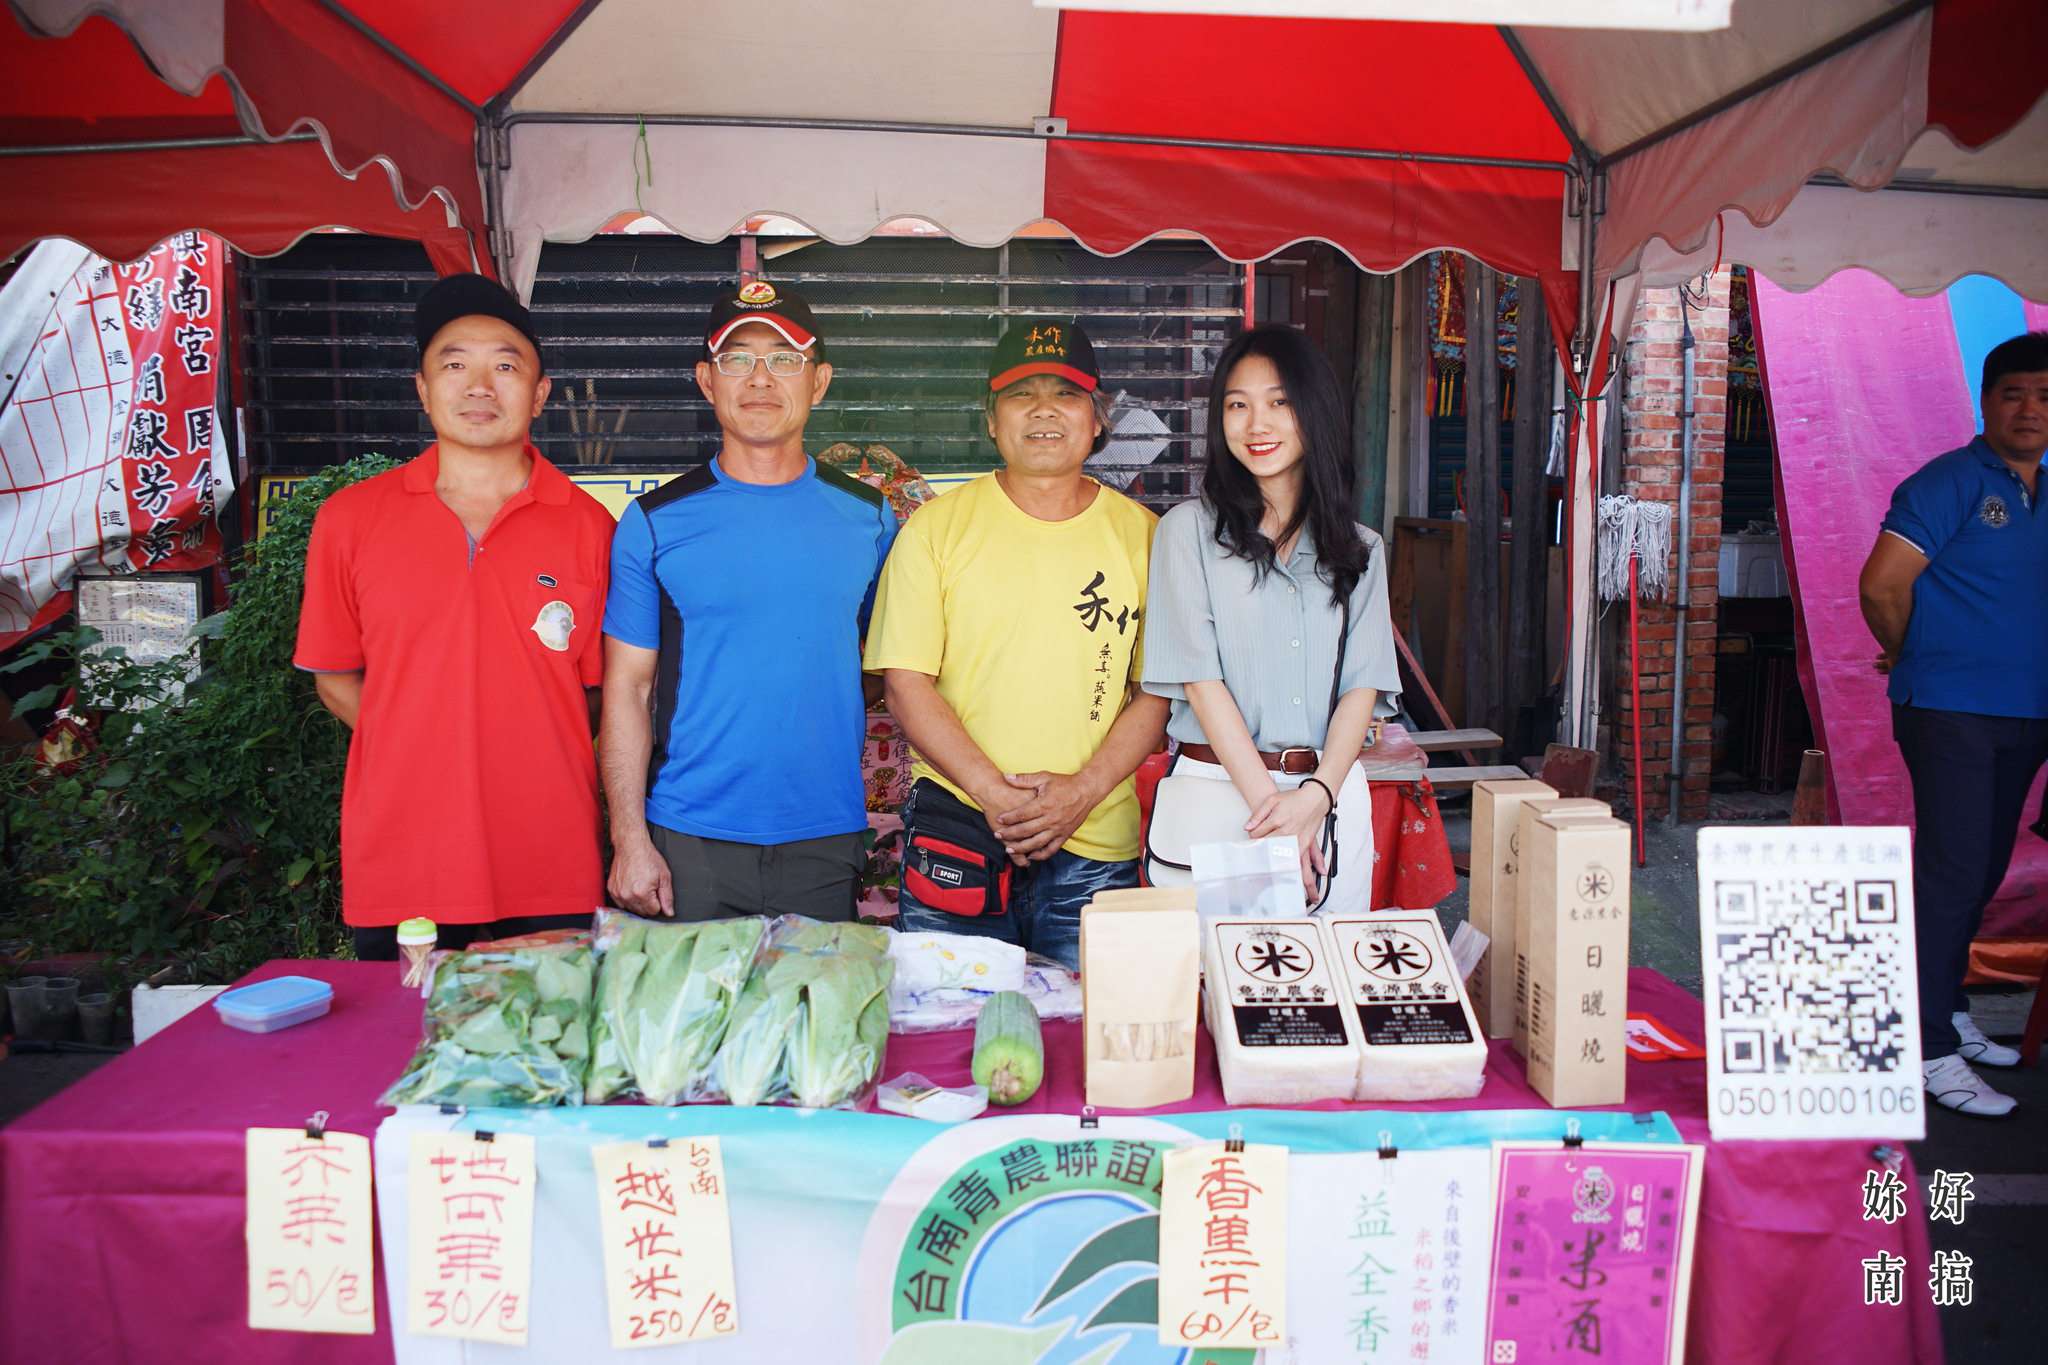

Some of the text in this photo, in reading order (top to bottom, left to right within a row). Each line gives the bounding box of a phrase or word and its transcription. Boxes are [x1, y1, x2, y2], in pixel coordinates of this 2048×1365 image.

[1583, 872, 1609, 899] 米
[1248, 941, 1306, 978] 米
[1367, 939, 1426, 976] 米
[1718, 1086, 1918, 1117] 0501000106
[903, 1140, 1163, 1315] 台南青農聯誼
[1346, 1189, 1397, 1365] 益全香
